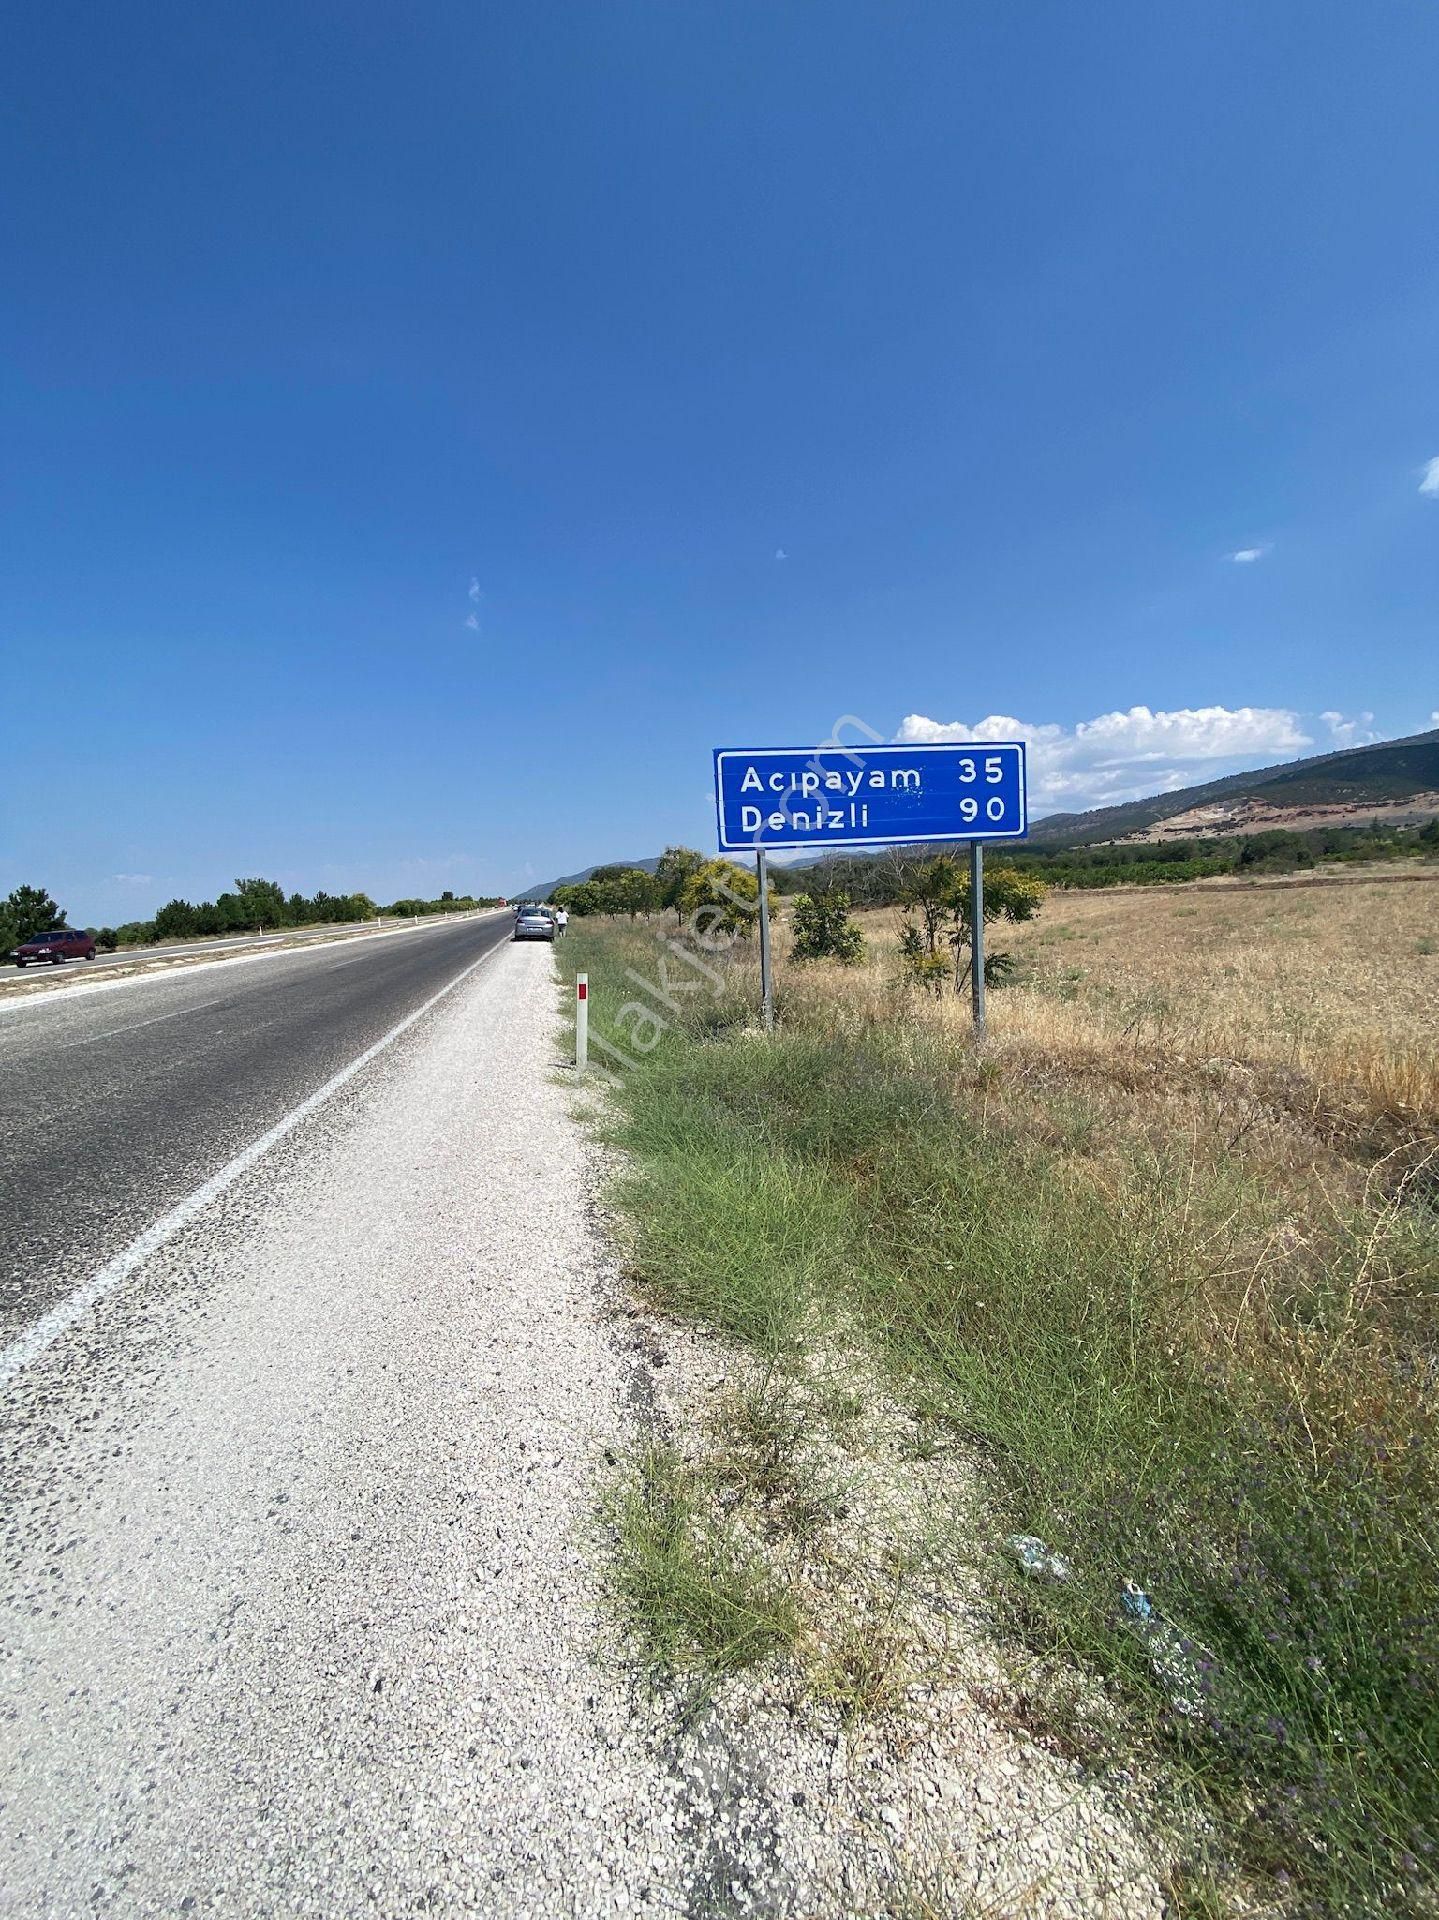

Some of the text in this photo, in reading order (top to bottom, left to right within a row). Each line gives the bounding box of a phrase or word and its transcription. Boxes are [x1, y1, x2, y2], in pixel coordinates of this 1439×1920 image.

[740, 756, 1003, 799] Acıpayam 35
[741, 796, 1005, 832] Denizli 90
